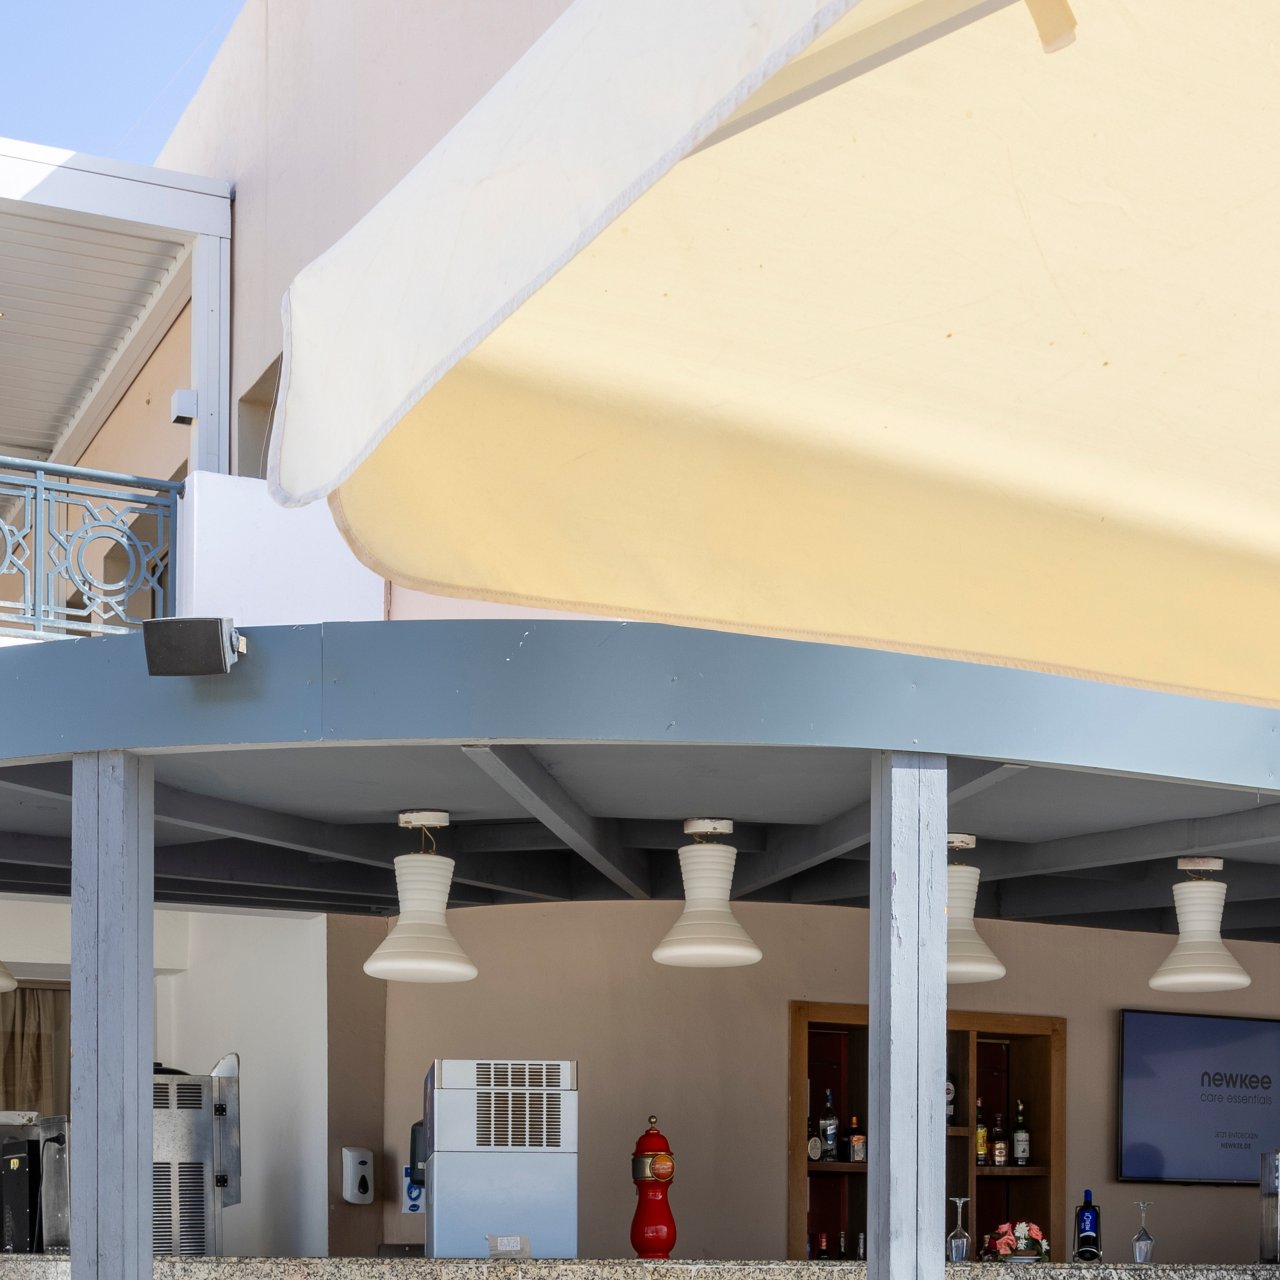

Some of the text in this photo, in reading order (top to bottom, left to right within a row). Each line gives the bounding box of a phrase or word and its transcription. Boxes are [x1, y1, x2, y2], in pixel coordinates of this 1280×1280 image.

[1200, 1071, 1273, 1090] newkee
[1200, 1093, 1273, 1105] care essentials
